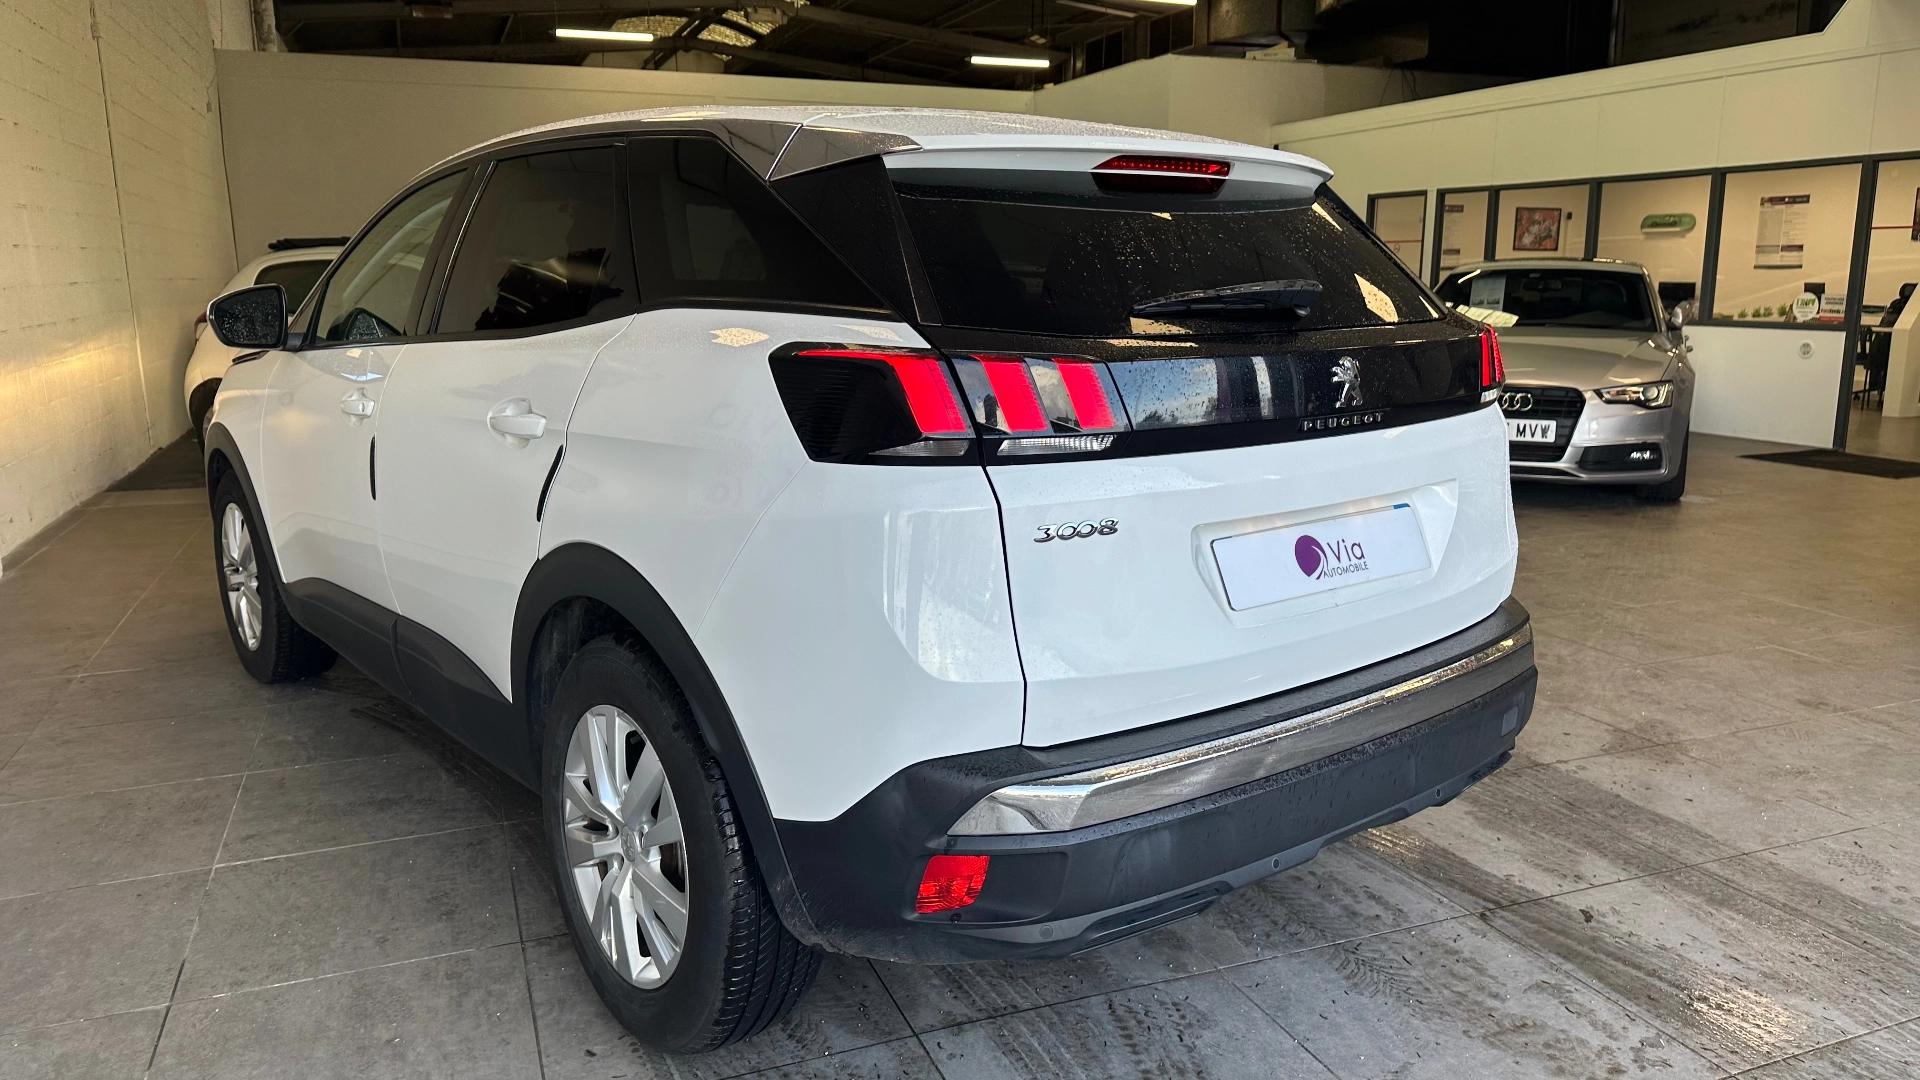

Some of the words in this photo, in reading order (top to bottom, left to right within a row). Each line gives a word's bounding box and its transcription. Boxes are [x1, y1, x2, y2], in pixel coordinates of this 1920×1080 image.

[1303, 412, 1383, 431] PEUGEOT
[1515, 423, 1551, 439] MVW
[1034, 518, 1119, 543] 3008
[1326, 538, 1366, 564] Via
[1323, 561, 1369, 579] AUTOMOBILE
